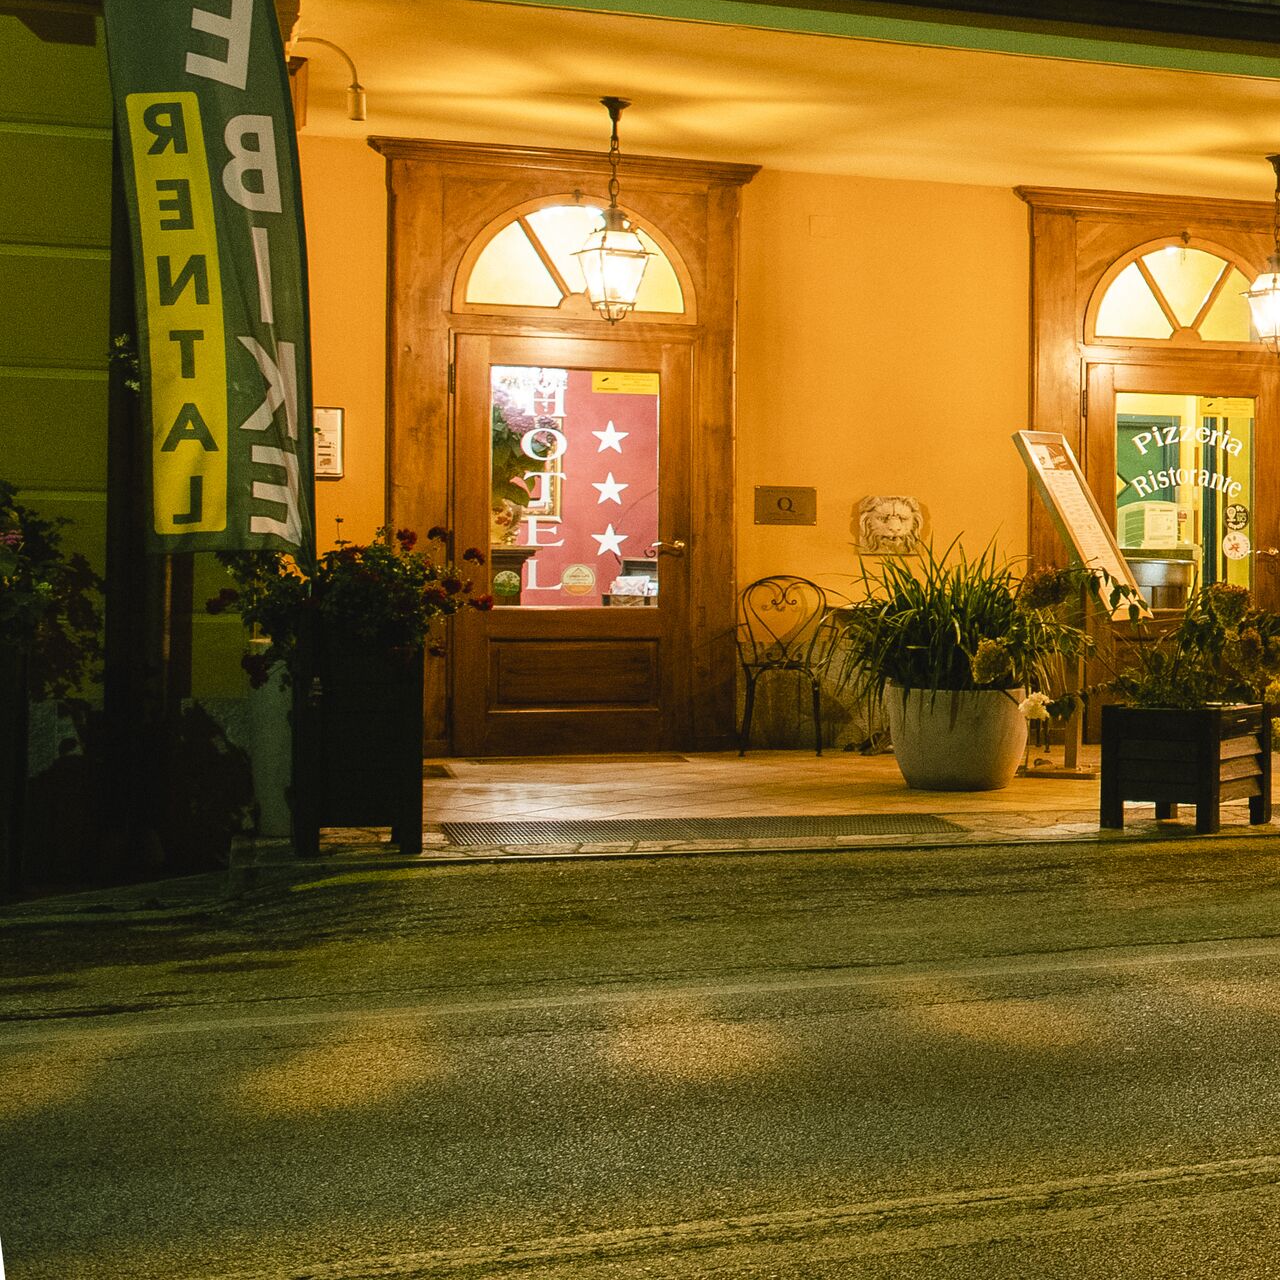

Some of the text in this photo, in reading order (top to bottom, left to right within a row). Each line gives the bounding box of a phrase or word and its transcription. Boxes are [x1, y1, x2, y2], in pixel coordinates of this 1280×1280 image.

[1131, 424, 1244, 457] Pizzeria
[520, 382, 568, 591] HOTEL
[1130, 465, 1244, 499] Ristorante
[777, 496, 796, 513] Q
